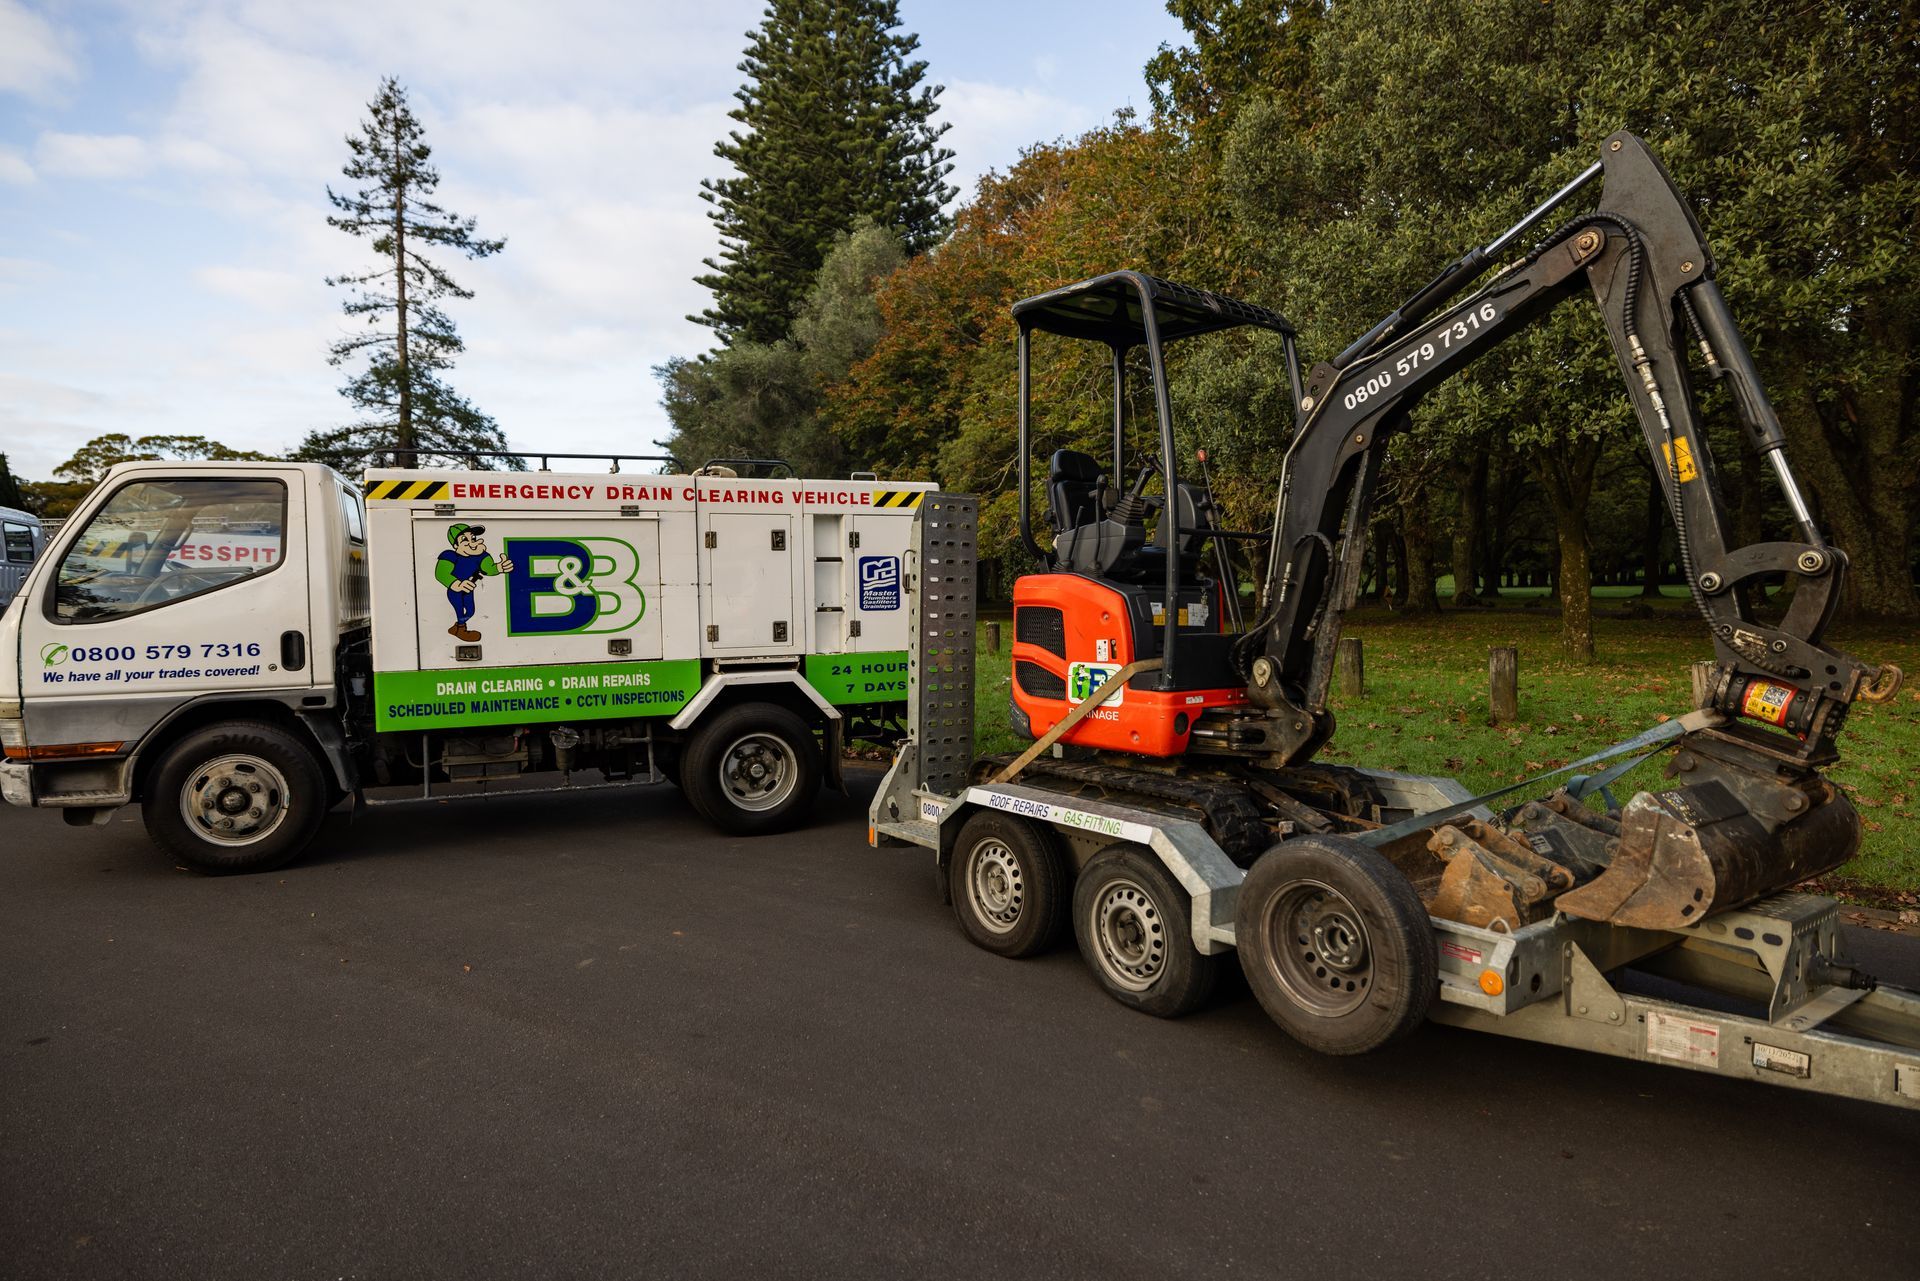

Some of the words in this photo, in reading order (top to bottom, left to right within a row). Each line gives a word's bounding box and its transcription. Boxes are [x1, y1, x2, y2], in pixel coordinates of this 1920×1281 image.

[1344, 371, 1392, 410] 0800
[1396, 343, 1435, 377] 579
[1438, 303, 1496, 348] 7316
[453, 484, 594, 499] EMERGENCY
[606, 486, 673, 500] DRAIN
[682, 487, 784, 504] CLEARING
[792, 490, 870, 505] VEHICLE
[168, 545, 276, 563] ESSPIT
[503, 537, 646, 637] B&B
[71, 647, 136, 662] 0800
[146, 644, 191, 660] 579
[200, 643, 261, 658] 7316
[43, 671, 64, 683] We
[68, 671, 101, 682] have
[105, 670, 121, 681] all
[124, 670, 155, 683] your
[158, 667, 201, 679] trades
[204, 665, 261, 677] covered!
[831, 665, 853, 676] 24
[861, 662, 908, 674] HOUR
[436, 681, 477, 696] DRAIN
[481, 678, 544, 694] CLEARING
[561, 675, 599, 690] DRAIN
[602, 673, 651, 688] REPAIRS
[845, 683, 856, 694] 7
[864, 680, 907, 693] DAYS
[388, 701, 466, 718] SCHEDULED
[470, 696, 560, 714] MAINTENANCE
[576, 693, 608, 708] CCTV
[611, 689, 685, 706] INSPECTIONS
[1068, 707, 1119, 721] DINAGE
[923, 802, 940, 817] 0800
[989, 794, 1011, 809] ROOF
[1012, 799, 1050, 818] REPAIRS
[1063, 810, 1084, 826] GAS
[1083, 815, 1121, 835] FITTING
